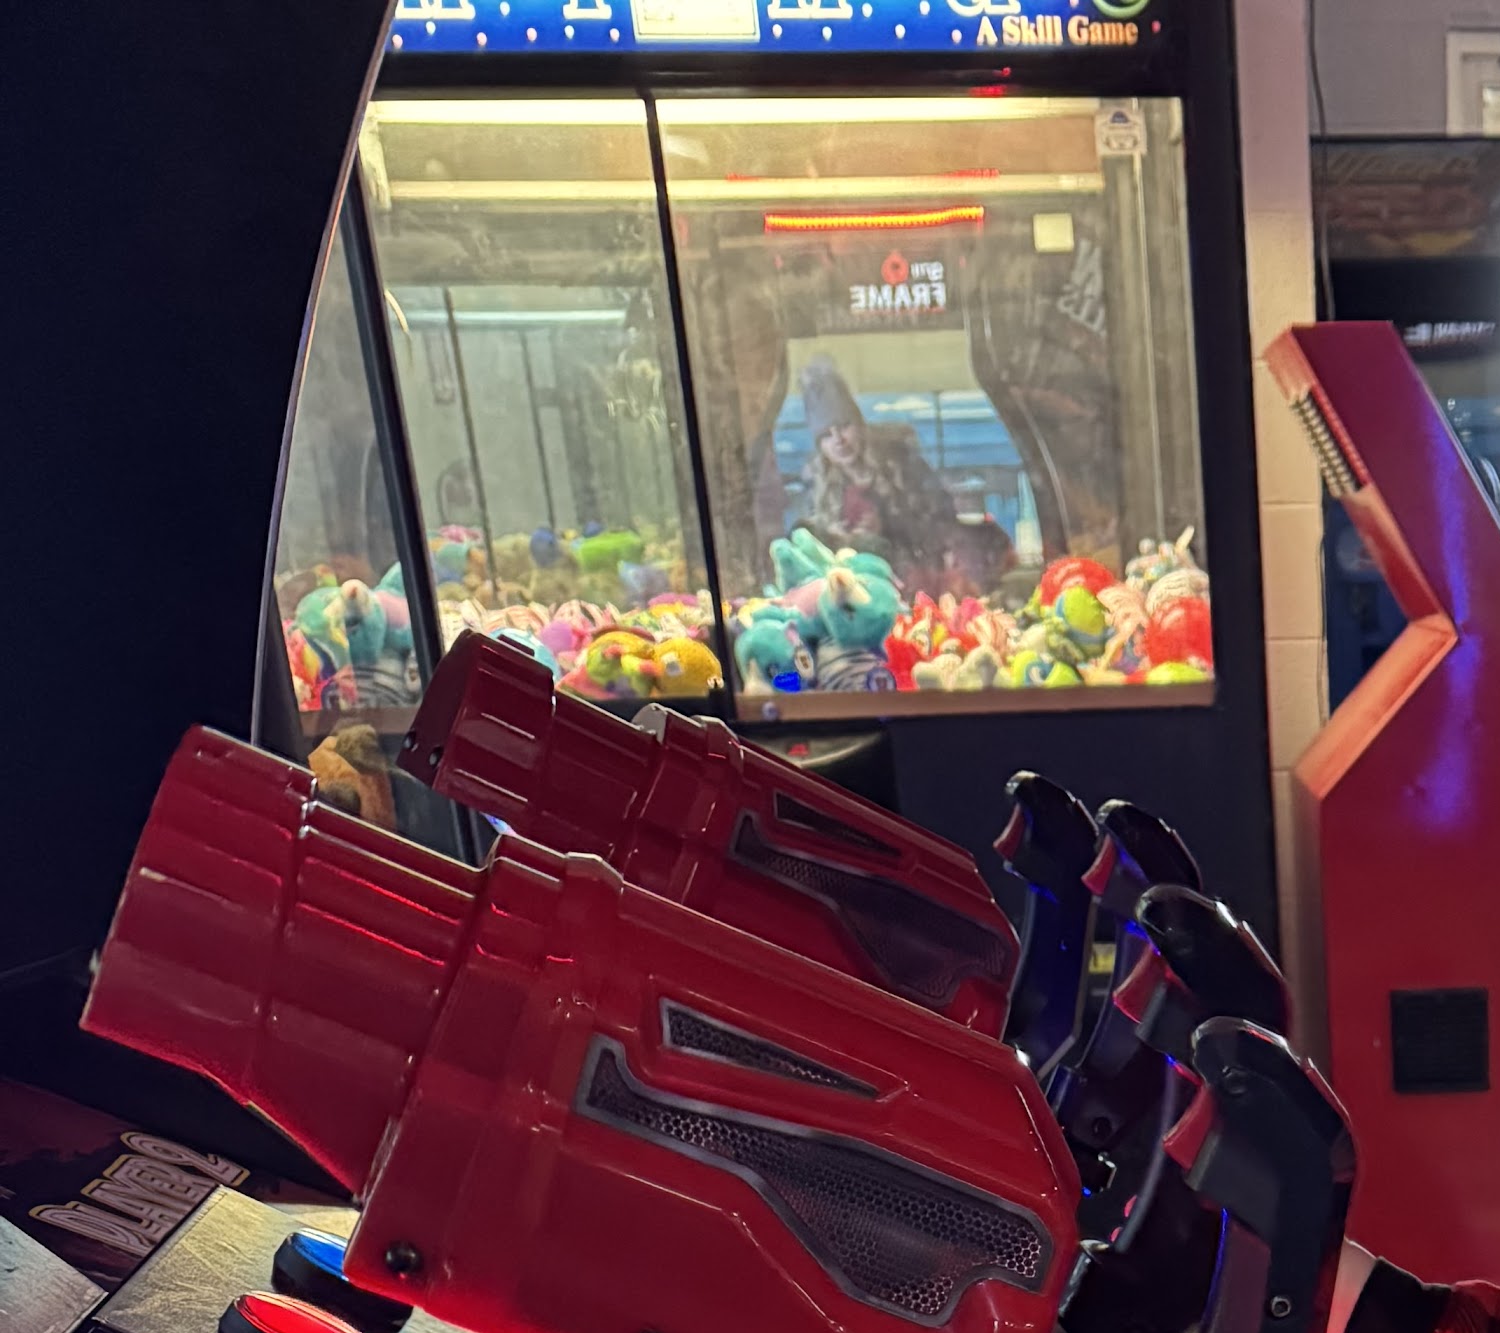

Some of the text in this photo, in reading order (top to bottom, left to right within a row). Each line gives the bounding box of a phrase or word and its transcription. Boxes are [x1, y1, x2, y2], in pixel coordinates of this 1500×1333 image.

[977, 14, 1138, 46] A Skill Game
[120, 1131, 251, 1187] 2
